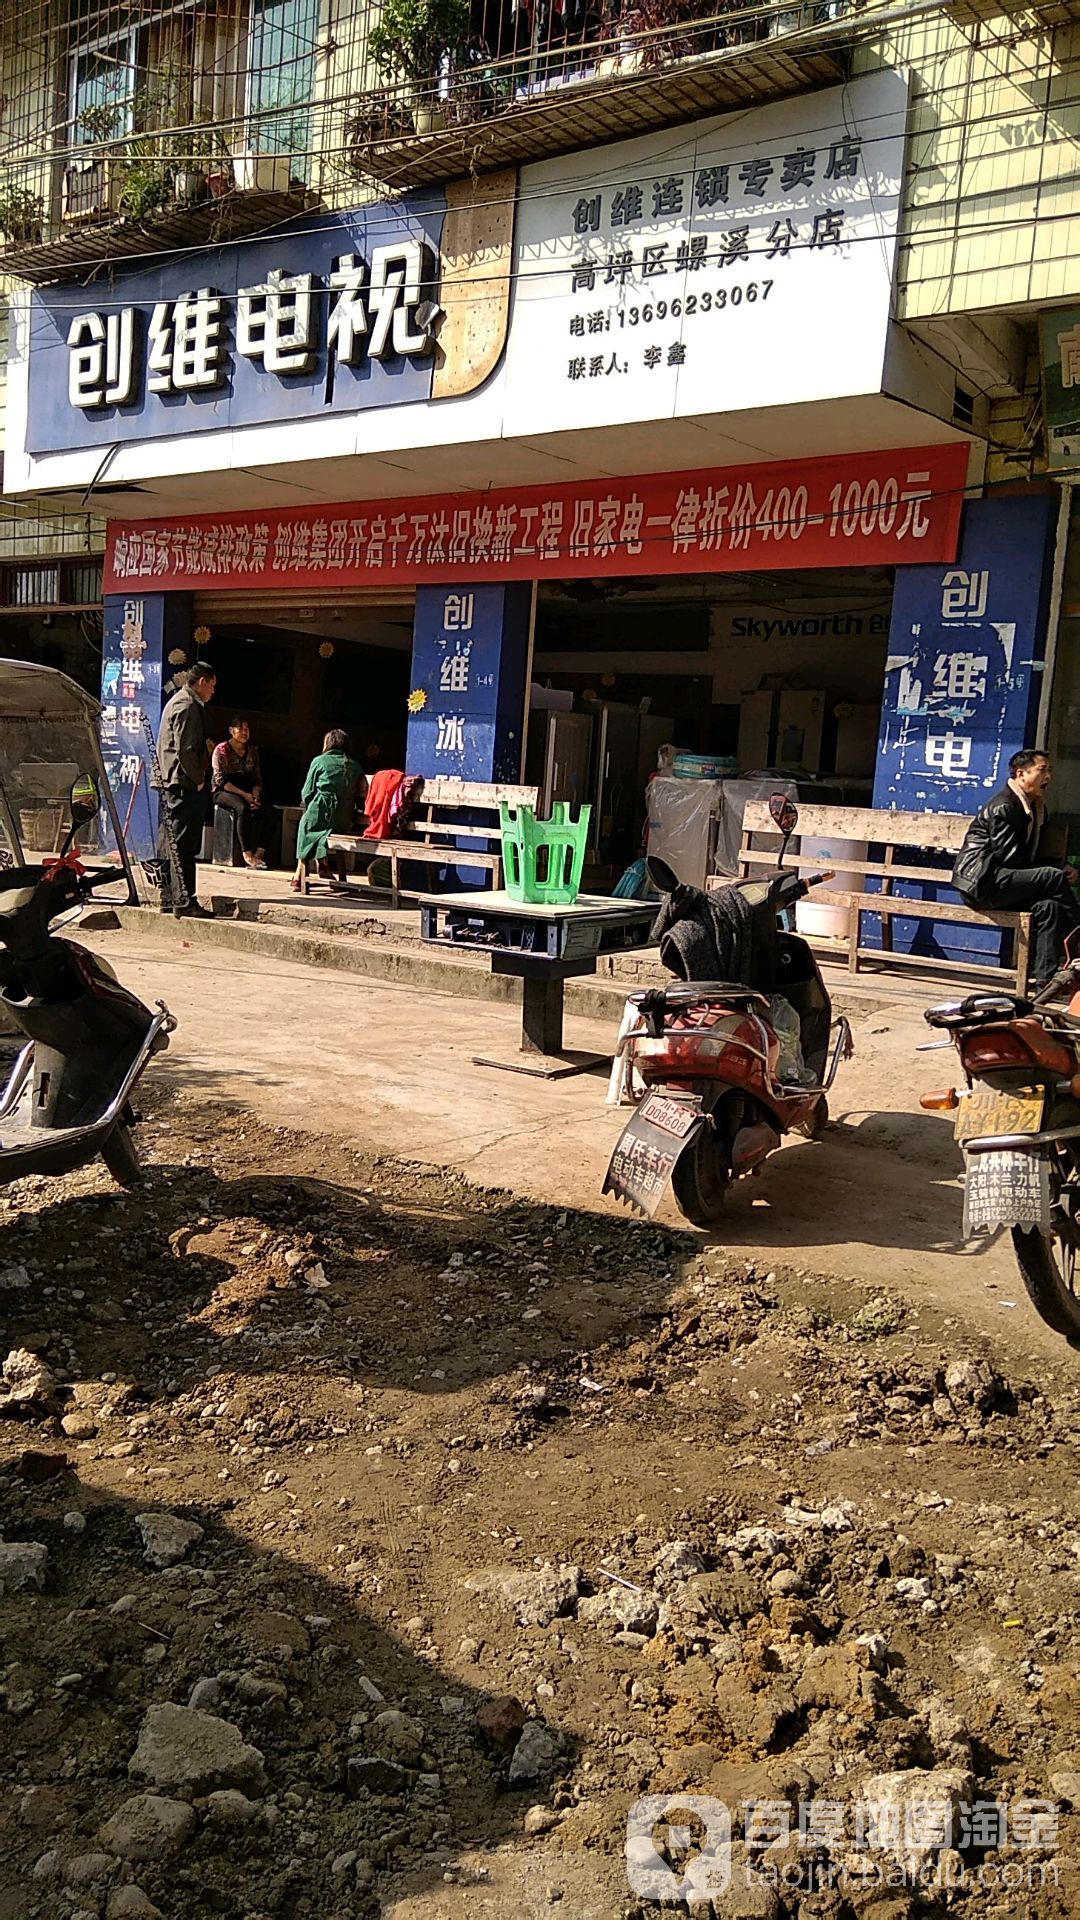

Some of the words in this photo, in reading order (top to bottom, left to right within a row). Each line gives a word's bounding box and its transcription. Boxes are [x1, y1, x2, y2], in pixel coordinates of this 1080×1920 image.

[571, 134, 863, 234] 创维连锁专卖店
[569, 208, 847, 294] 高坪区螺溪分店
[66, 239, 437, 410] 创维电视
[731, 614, 863, 642] Skyworth
[435, 593, 475, 783] 创维冰
[925, 570, 989, 815] 创维电
[645, 1104, 686, 1132] D08608
[612, 1155, 665, 1194] 电动车超市
